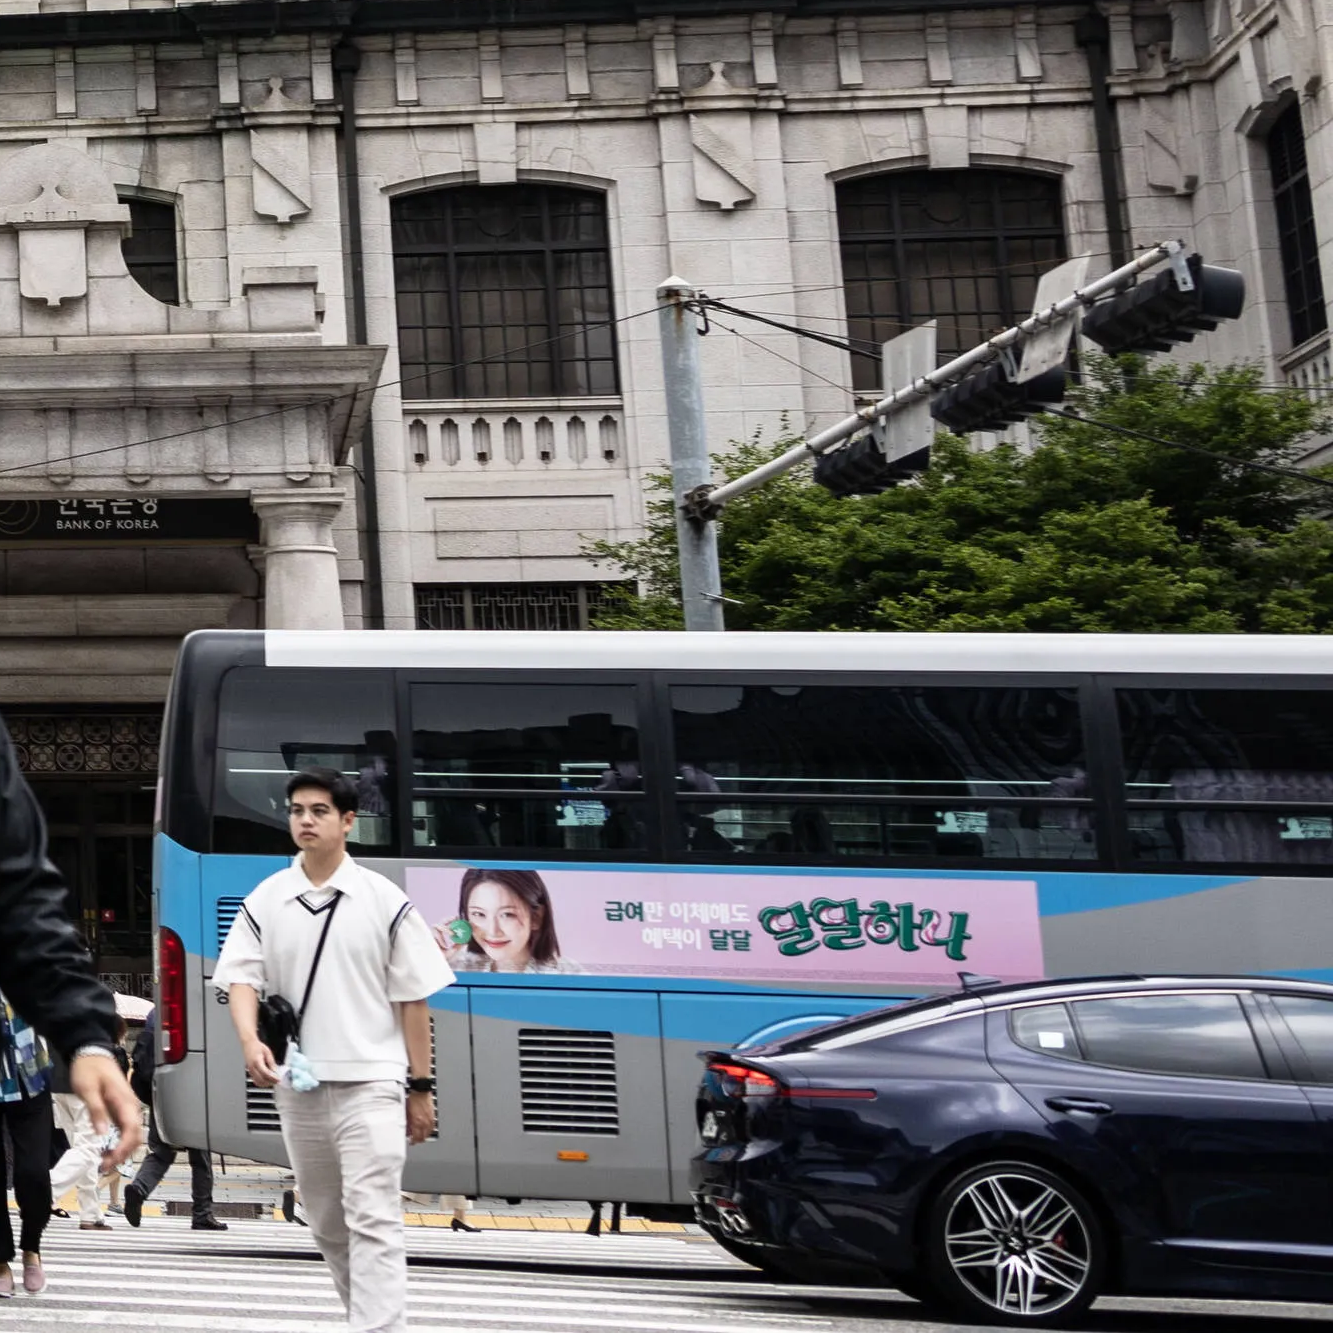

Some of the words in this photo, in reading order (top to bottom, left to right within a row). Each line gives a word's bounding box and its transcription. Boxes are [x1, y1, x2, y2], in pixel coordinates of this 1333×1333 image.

[56, 520, 91, 530] BANK
[94, 520, 112, 530] OF
[116, 520, 159, 530] KOREA
[604, 900, 664, 923] 급여만
[669, 901, 751, 924] 이체해도
[642, 927, 702, 950] 혜택이
[709, 928, 752, 952] 달달
[758, 896, 972, 961] 달달하나
